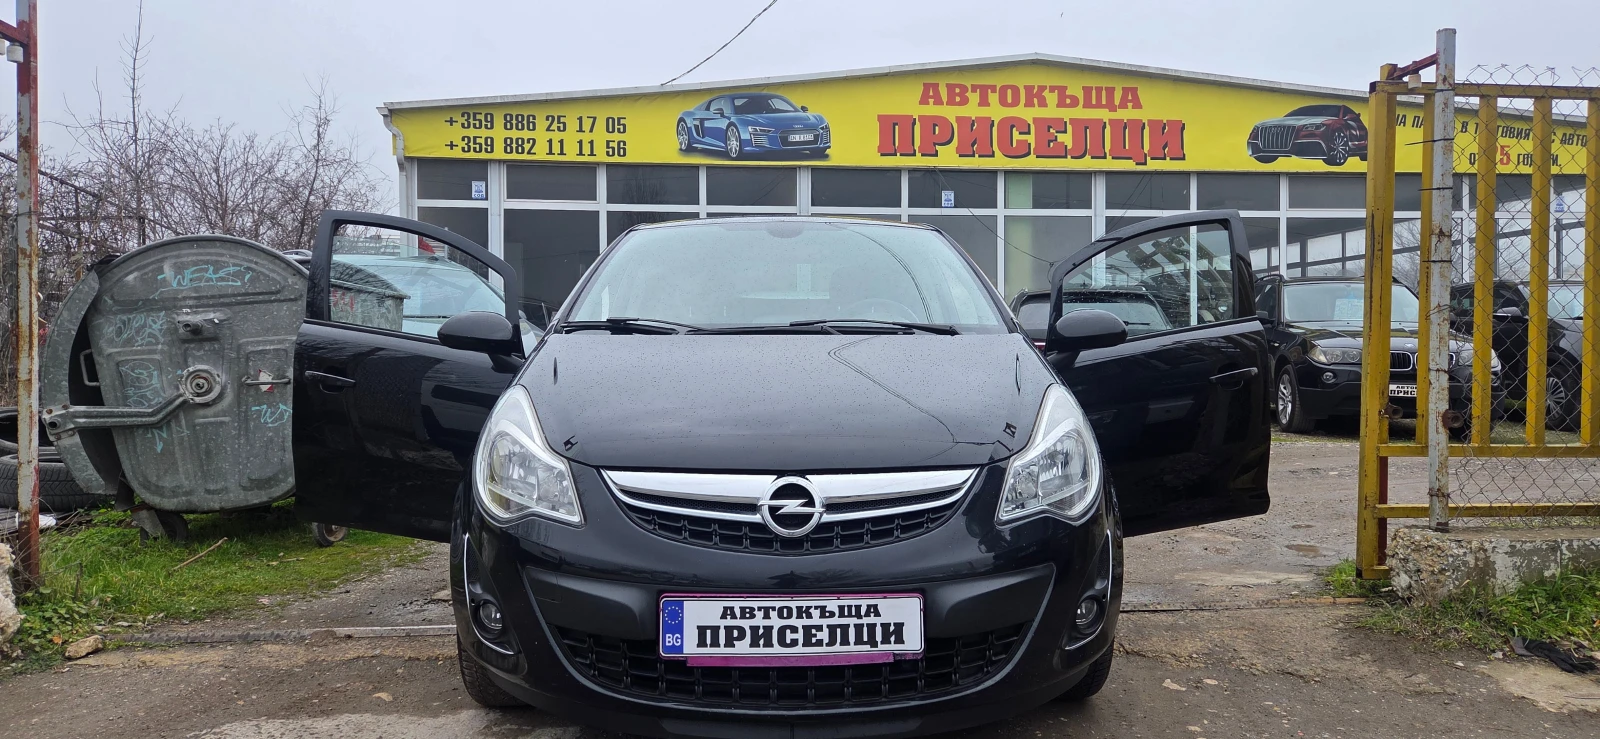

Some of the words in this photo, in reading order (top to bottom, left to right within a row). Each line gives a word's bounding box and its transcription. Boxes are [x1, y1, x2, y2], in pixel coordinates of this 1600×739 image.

[918, 82, 1143, 112] АВТОКЪЩА
[444, 111, 494, 130] +359
[503, 113, 537, 132] 886
[545, 114, 567, 133] 25
[576, 115, 597, 133] 17
[605, 116, 627, 134] 05
[444, 135, 494, 154] +359
[503, 136, 537, 155] 882
[545, 138, 567, 157] 11
[576, 139, 597, 157] 11
[605, 139, 627, 158] 56
[877, 114, 1186, 166] ПРИСЕЛЦИ
[719, 603, 882, 620] АВТОКЪЩА
[665, 633, 682, 646] BG
[696, 621, 905, 649] ПРИСЕЛЦИ
